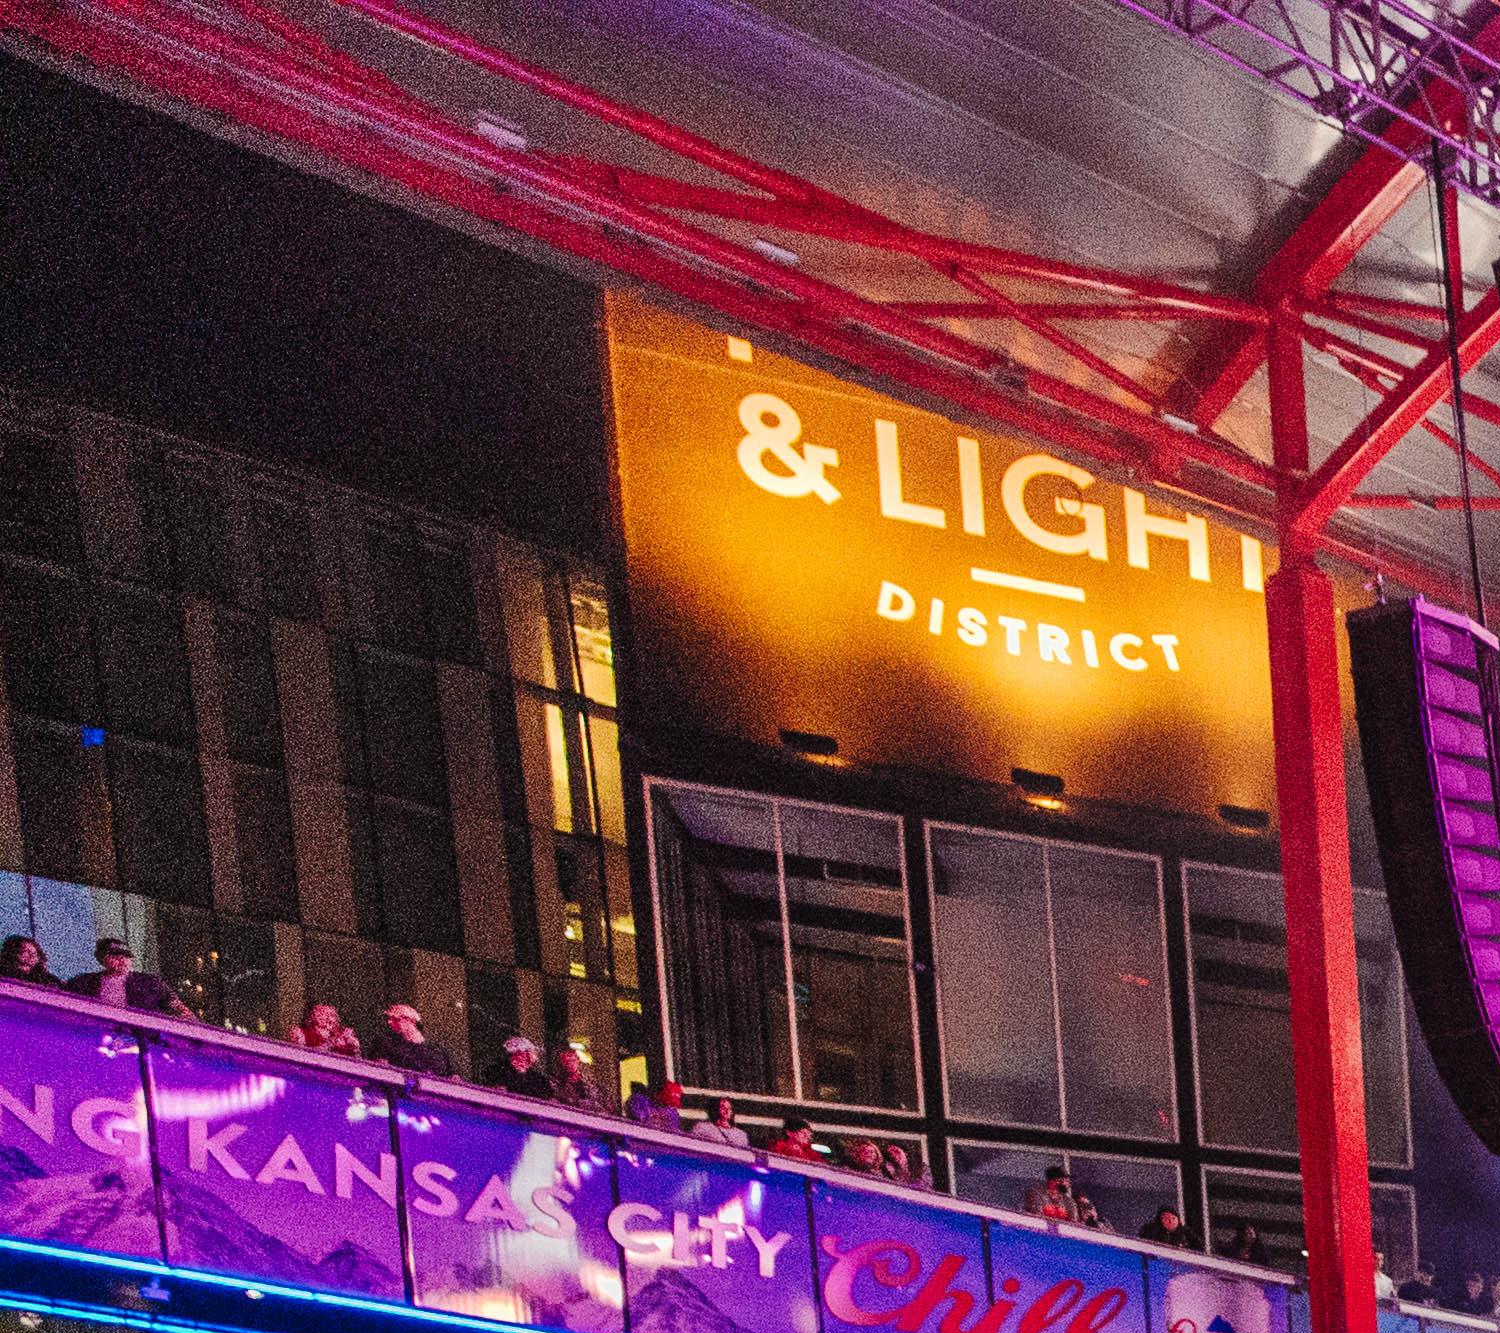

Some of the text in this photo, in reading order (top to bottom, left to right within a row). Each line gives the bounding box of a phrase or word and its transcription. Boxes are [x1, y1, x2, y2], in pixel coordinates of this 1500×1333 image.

[737, 392, 842, 503] &
[876, 581, 1182, 672] DISTRICT
[187, 1121, 578, 1239] KANSAS
[607, 1201, 792, 1280] CITY
